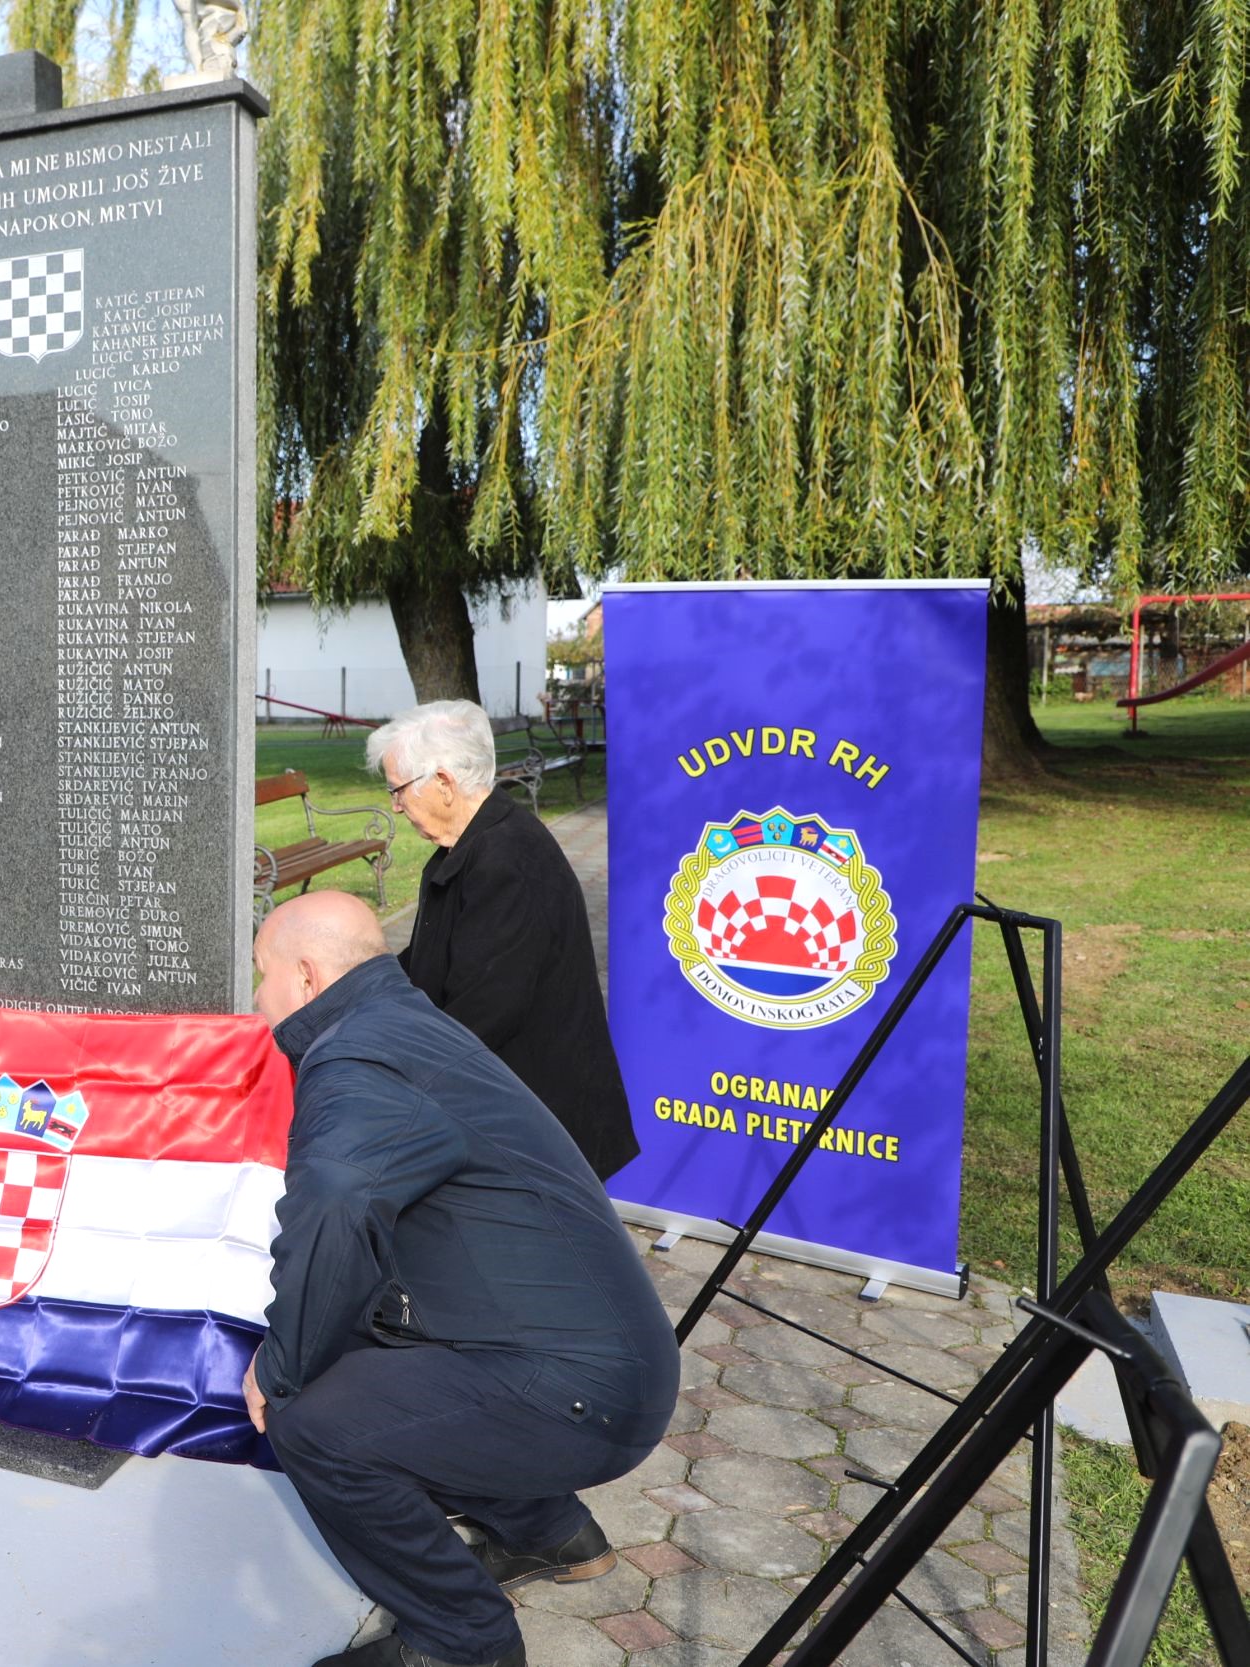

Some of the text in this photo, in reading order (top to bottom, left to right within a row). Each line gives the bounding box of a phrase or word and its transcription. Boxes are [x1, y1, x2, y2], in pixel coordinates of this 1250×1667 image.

[11, 159, 31, 178] MI
[36, 153, 59, 174] NE
[65, 144, 123, 169] BISMO
[129, 130, 213, 159] NESTALI
[23, 178, 104, 206] UMORILI
[112, 168, 149, 195] JOŠ
[158, 164, 204, 186] ŽIVE
[100, 199, 163, 223] MRTVI
[95, 285, 205, 309] KATIĆ STJEPAN
[104, 303, 192, 323] KATIĆ JOSIP
[162, 313, 224, 330] ANDRIJA
[92, 328, 223, 352] KAHANEK STJEPAN
[142, 343, 202, 360] STJEPAN
[133, 361, 180, 376] KARLO
[113, 380, 152, 393] IVICA
[113, 394, 150, 408] JOSIP
[111, 408, 153, 422] TOMO
[123, 421, 167, 436] MITAR
[58, 453, 142, 470] MIKIĆ JOSIP
[58, 466, 187, 485] PETKOVIĆ ANTUN
[58, 480, 172, 498] PETKOVIĆ IVAN
[136, 494, 178, 508] MATO
[136, 508, 186, 522] ANTUN
[118, 526, 168, 540] MARKO
[118, 542, 176, 556] STJEPAN
[118, 557, 167, 570] ANTUN
[118, 573, 172, 587] FRANJO
[118, 587, 157, 599] PAVO
[58, 601, 192, 615] RUKAVINA NIKOLA
[58, 617, 175, 631] RUKAVINA IVAN
[58, 631, 195, 645] RUKAVINA STJEPAN
[58, 648, 174, 660] RUKAVINA JOSIP
[123, 663, 173, 675] ANTUN
[123, 679, 164, 690] MATO
[123, 693, 173, 705] DANKO
[150, 723, 200, 735] ANTUN
[150, 738, 208, 750] STJEPAN
[152, 753, 188, 765] IVAN
[677, 726, 892, 789] UDVDR RH
[152, 768, 208, 780] FRANJO
[143, 781, 178, 793] IVAN
[143, 795, 188, 807] MARIN
[121, 809, 183, 822] MARIJAN
[121, 824, 162, 836] MATO
[121, 837, 170, 849] ANTUN
[118, 865, 153, 879] IVAN
[118, 880, 176, 894] STJEPAN
[702, 850, 857, 911] DRAGOVOLJCI I VETERANI
[120, 895, 162, 909] PETAR
[148, 940, 190, 953] TOMO
[148, 956, 190, 969] JULKA
[148, 970, 197, 984] ANTUN
[108, 983, 141, 995] IVAN
[696, 970, 857, 1020] DOMOVINSKOG RATA
[654, 1096, 738, 1133] GRADA
